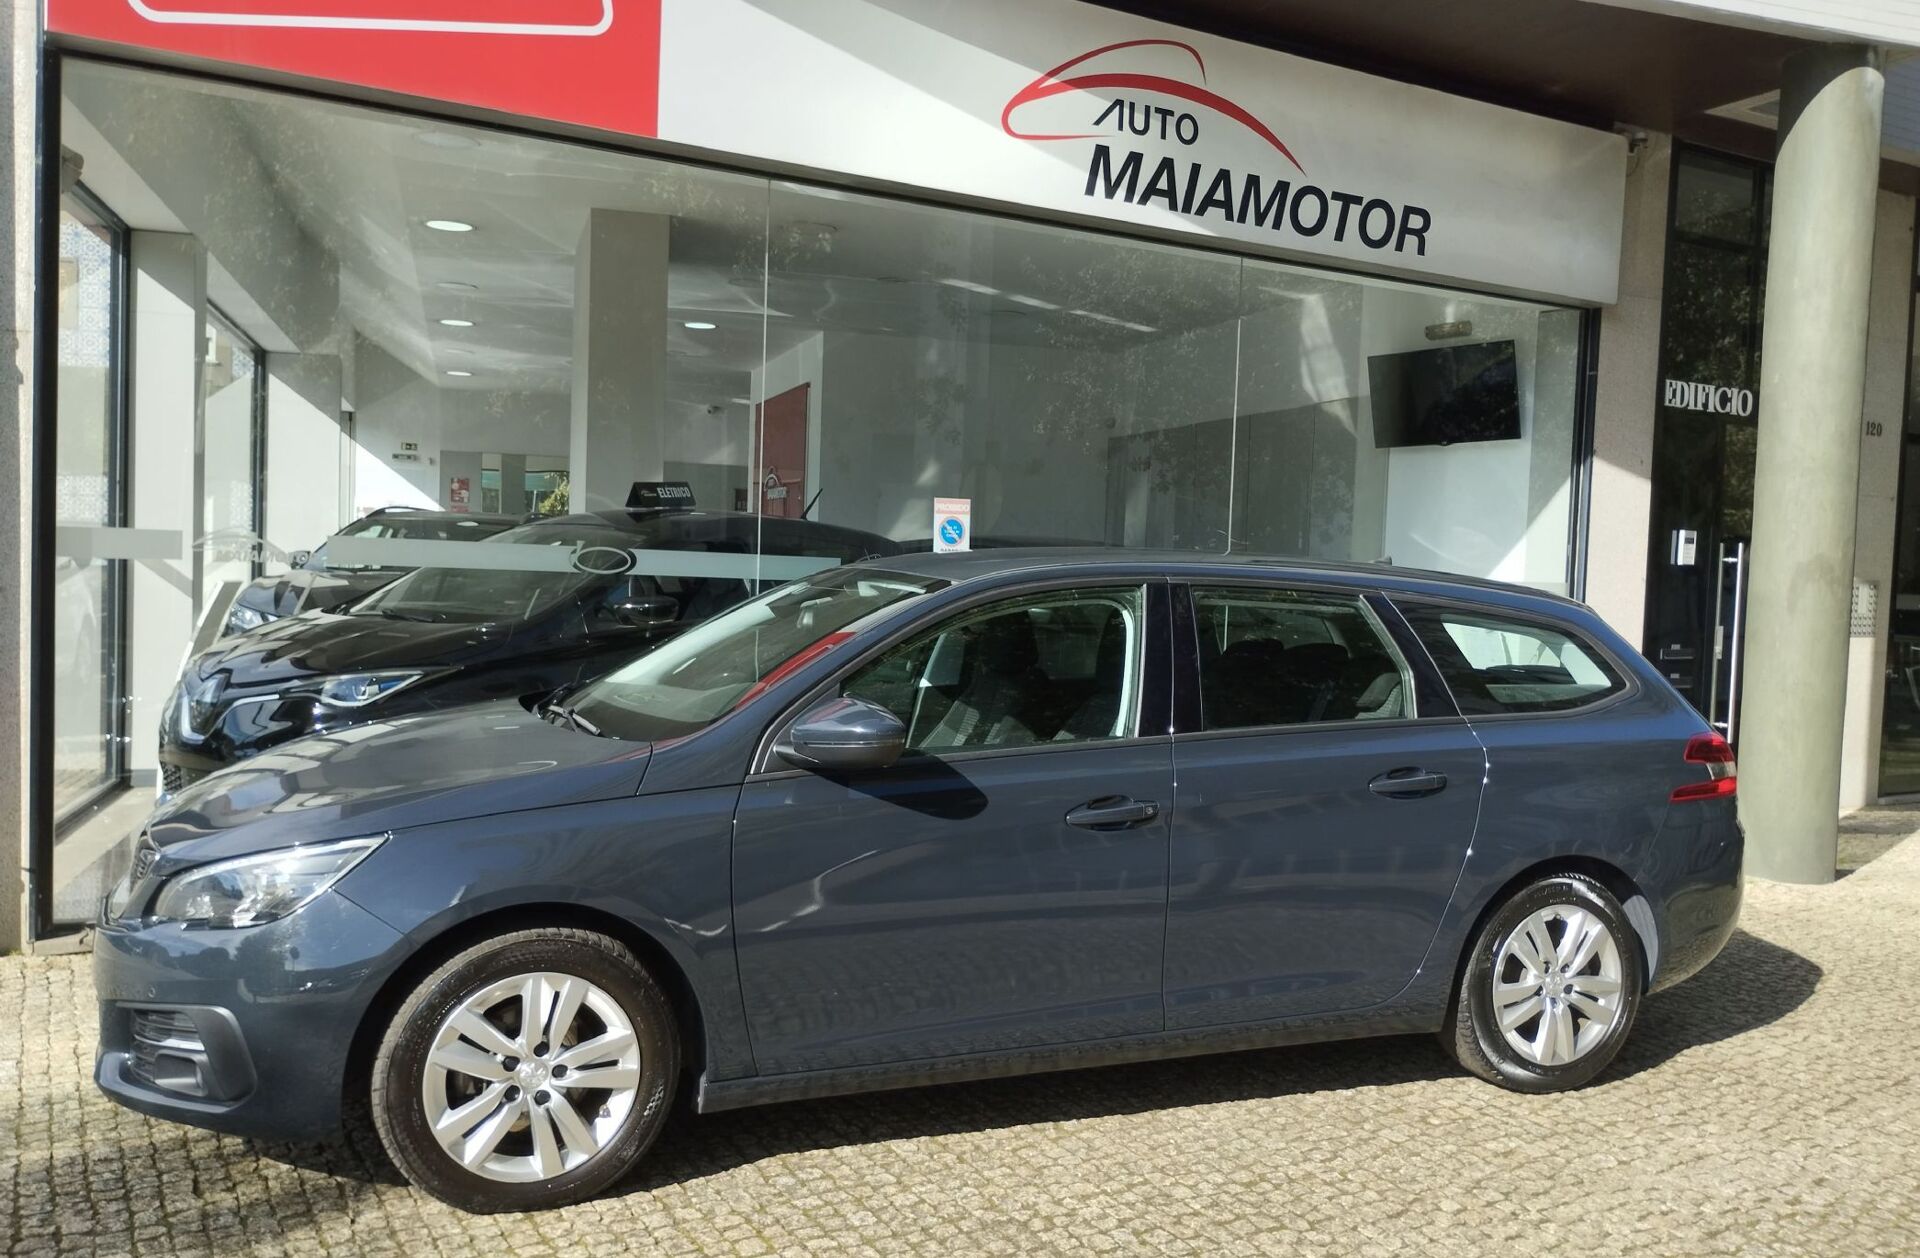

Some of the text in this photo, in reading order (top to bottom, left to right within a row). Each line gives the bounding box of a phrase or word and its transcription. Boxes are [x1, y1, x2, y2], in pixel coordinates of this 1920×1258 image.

[1092, 98, 1199, 146] AUTO
[1084, 143, 1432, 257] MAIAMOTOR
[1664, 378, 1753, 417] EDIFICIO
[1866, 421, 1883, 437] 120
